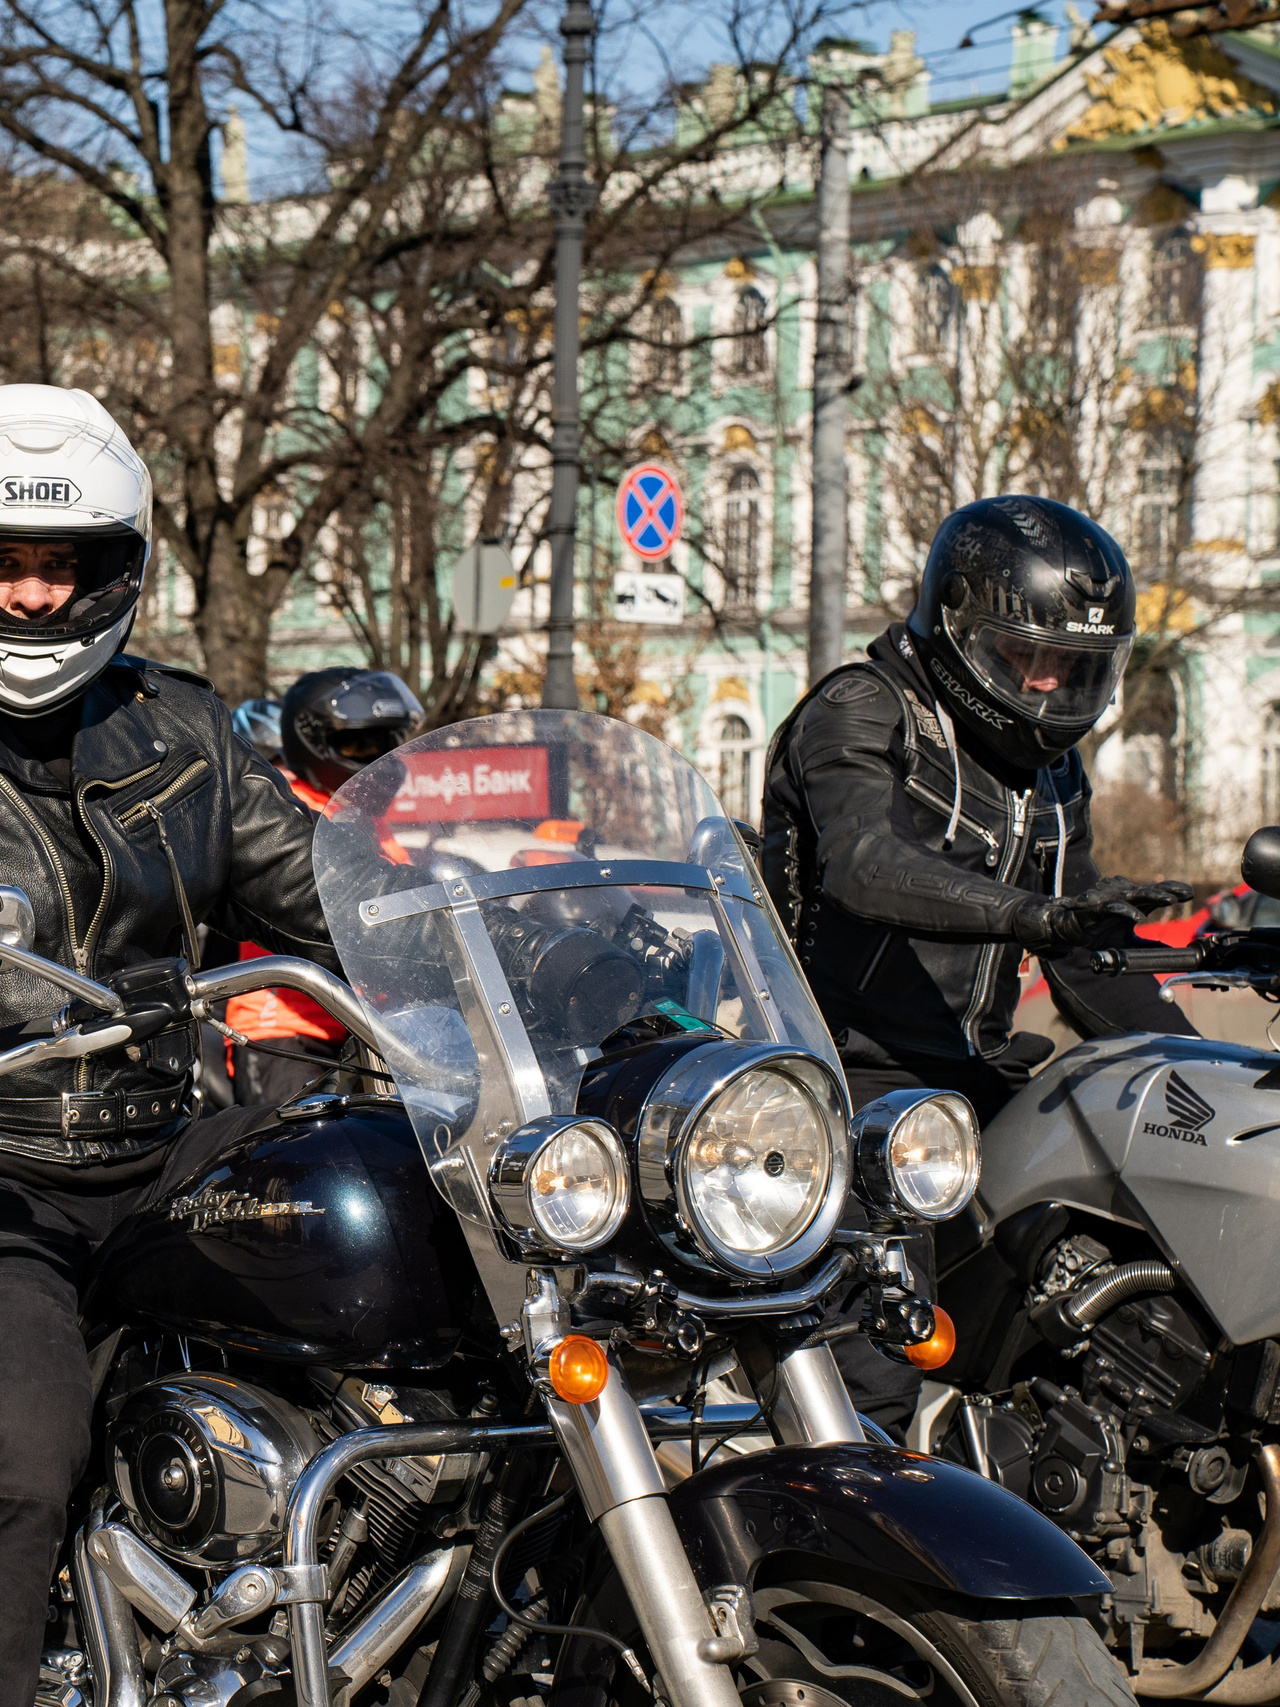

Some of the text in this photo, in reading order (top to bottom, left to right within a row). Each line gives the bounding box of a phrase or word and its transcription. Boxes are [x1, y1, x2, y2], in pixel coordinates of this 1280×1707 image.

[5, 481, 70, 502] SHOEI
[1066, 621, 1115, 635] SHARK
[930, 657, 1014, 731] SHARK
[473, 763, 532, 796] Банк
[1142, 1122, 1208, 1147] HONDA
[914, 1611, 997, 1707] TTLECRU
